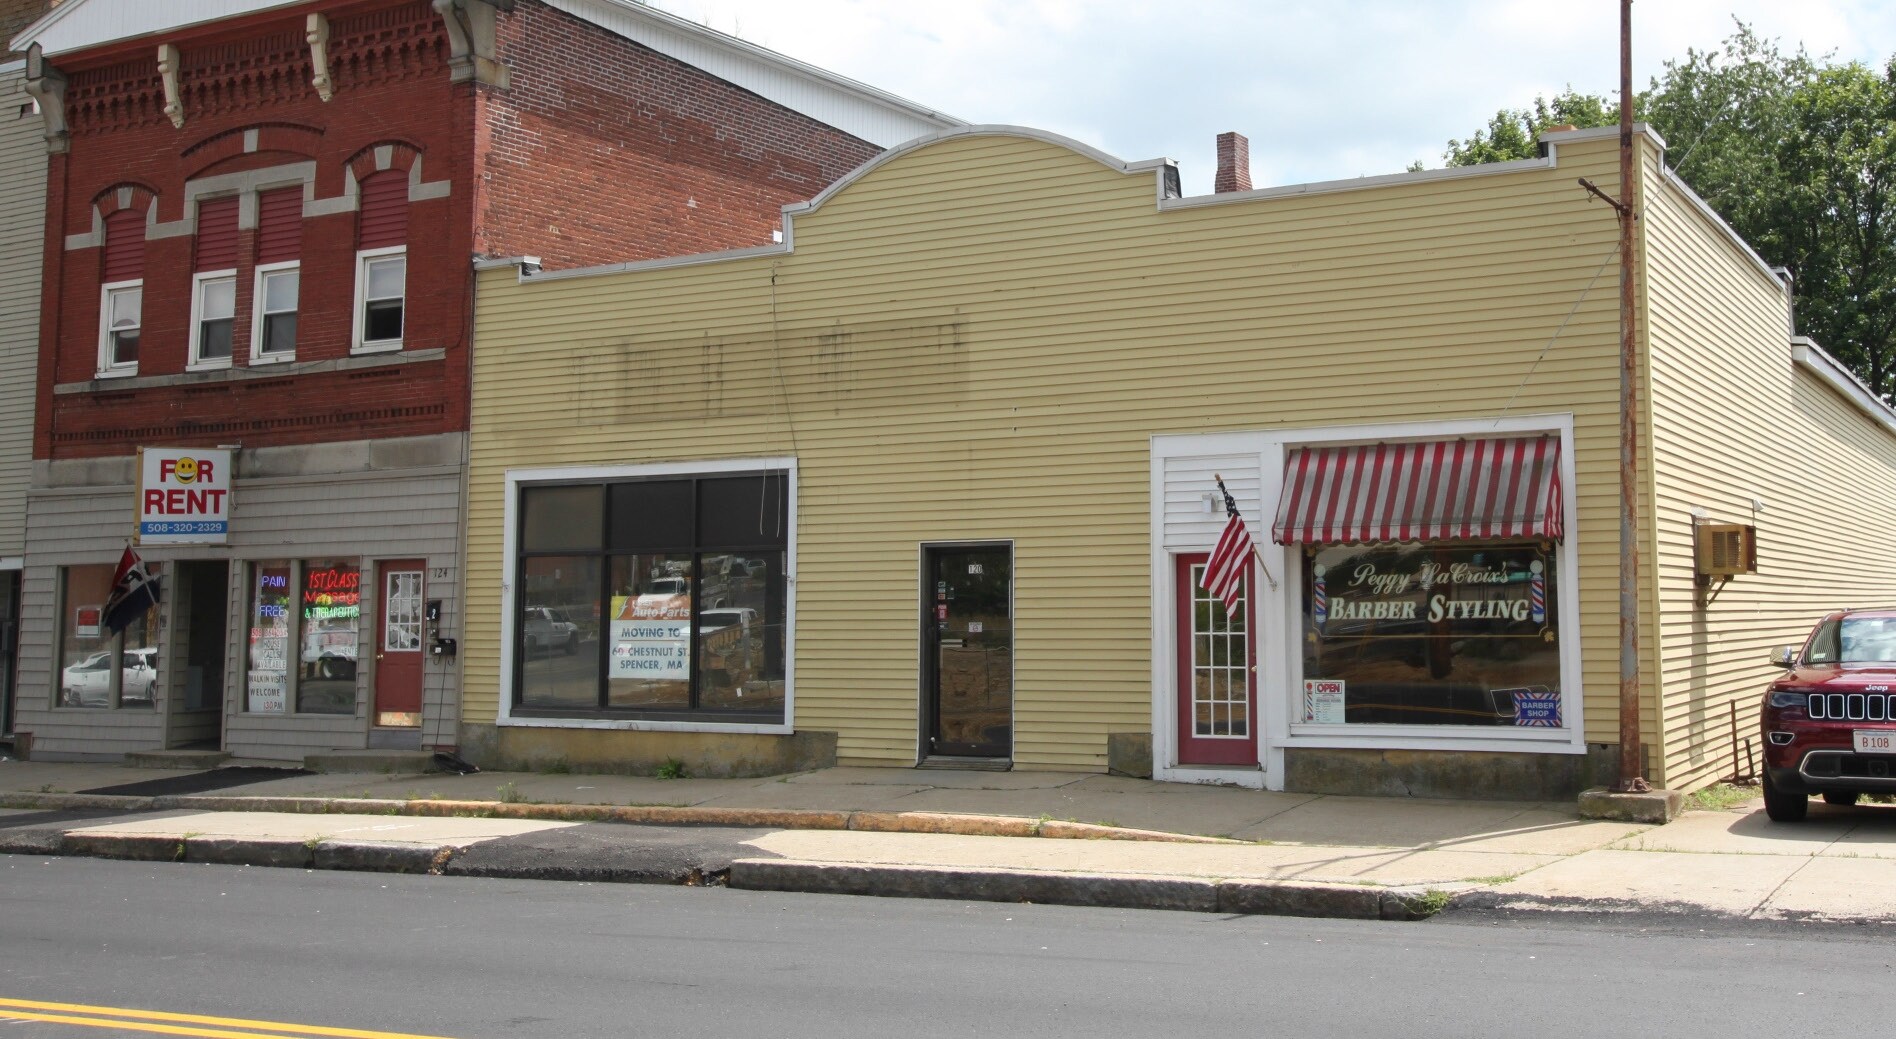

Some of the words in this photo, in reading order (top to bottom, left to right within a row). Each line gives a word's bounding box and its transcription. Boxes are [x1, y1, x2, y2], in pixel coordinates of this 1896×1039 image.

[144, 488, 227, 515] RENT
[147, 522, 222, 533] 508-320-2329
[433, 567, 448, 578] 124
[968, 564, 983, 574] 120
[261, 575, 286, 587] PAIN
[309, 570, 327, 589] 1ST
[1348, 563, 1411, 595] Peggy
[259, 604, 286, 617] FREE
[304, 607, 311, 619] &
[632, 608, 658, 618] Auto
[660, 606, 690, 618] Parts
[1328, 597, 1416, 620] BARBER
[1427, 594, 1530, 623] STYLING
[621, 627, 664, 638] MOVING
[668, 627, 681, 638] TO
[612, 649, 624, 657] 60
[628, 647, 673, 657] CHESTNUT
[620, 660, 663, 671] SPENCER,
[667, 660, 683, 670] MA
[250, 688, 281, 697] WELCOME
[1316, 683, 1341, 694] OPEN
[1865, 684, 1889, 692] Jeep
[1521, 702, 1555, 710] BARBER
[1526, 709, 1550, 718] SHOP
[1862, 737, 1869, 748] B
[1871, 737, 1890, 748] 108
